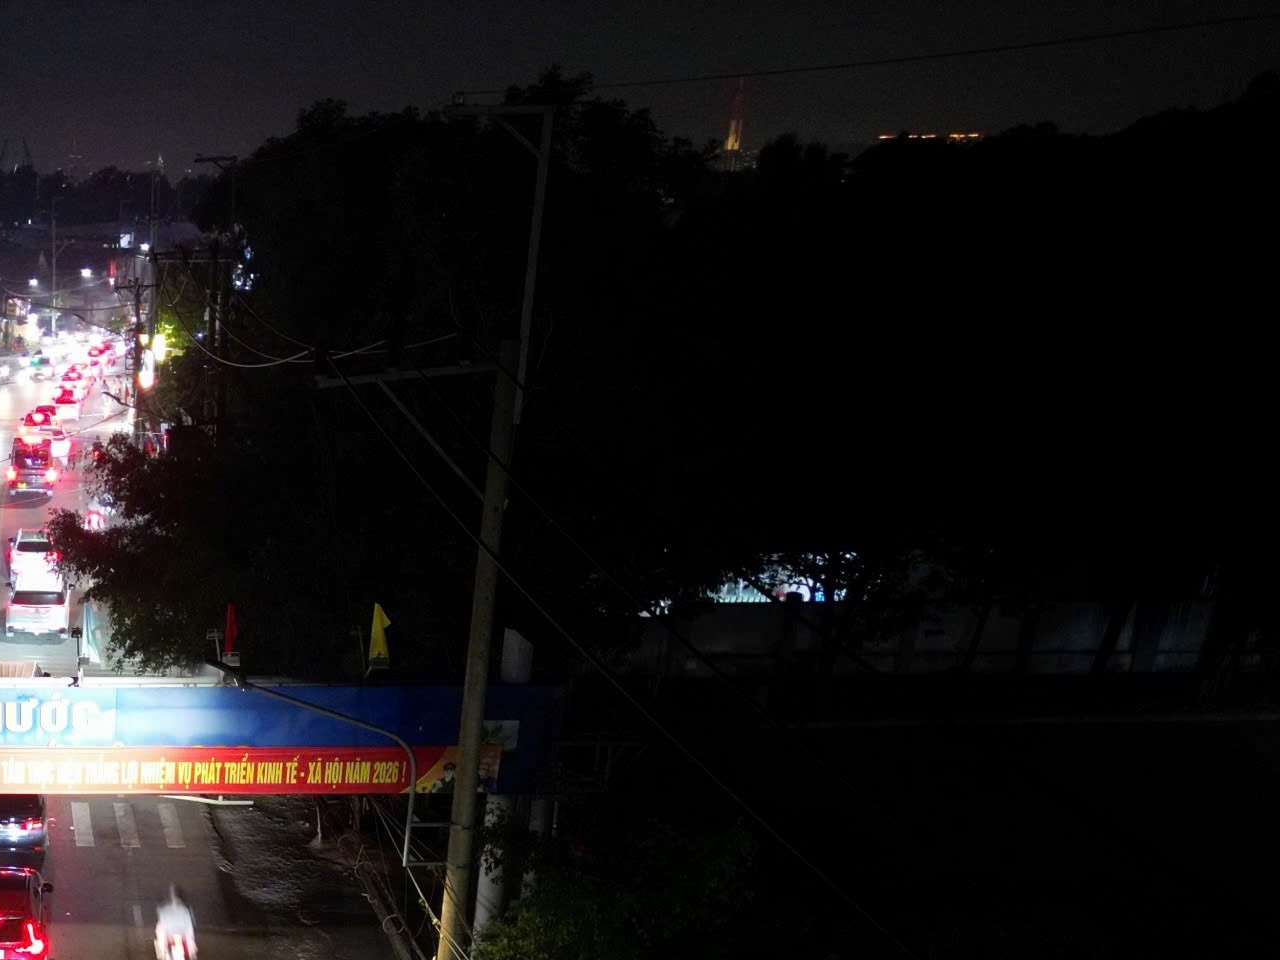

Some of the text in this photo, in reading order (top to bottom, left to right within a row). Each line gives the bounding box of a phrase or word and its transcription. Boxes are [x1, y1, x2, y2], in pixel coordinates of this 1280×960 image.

[178, 761, 192, 789] VỤ
[193, 757, 221, 784] PHÁT
[224, 753, 254, 784] TRIỂN
[257, 762, 283, 784] KINH
[285, 755, 300, 784] TẾ
[307, 757, 322, 784] XÃ
[324, 757, 344, 789] HỘI
[345, 757, 370, 784] NĂM
[372, 761, 399, 784] 2026
